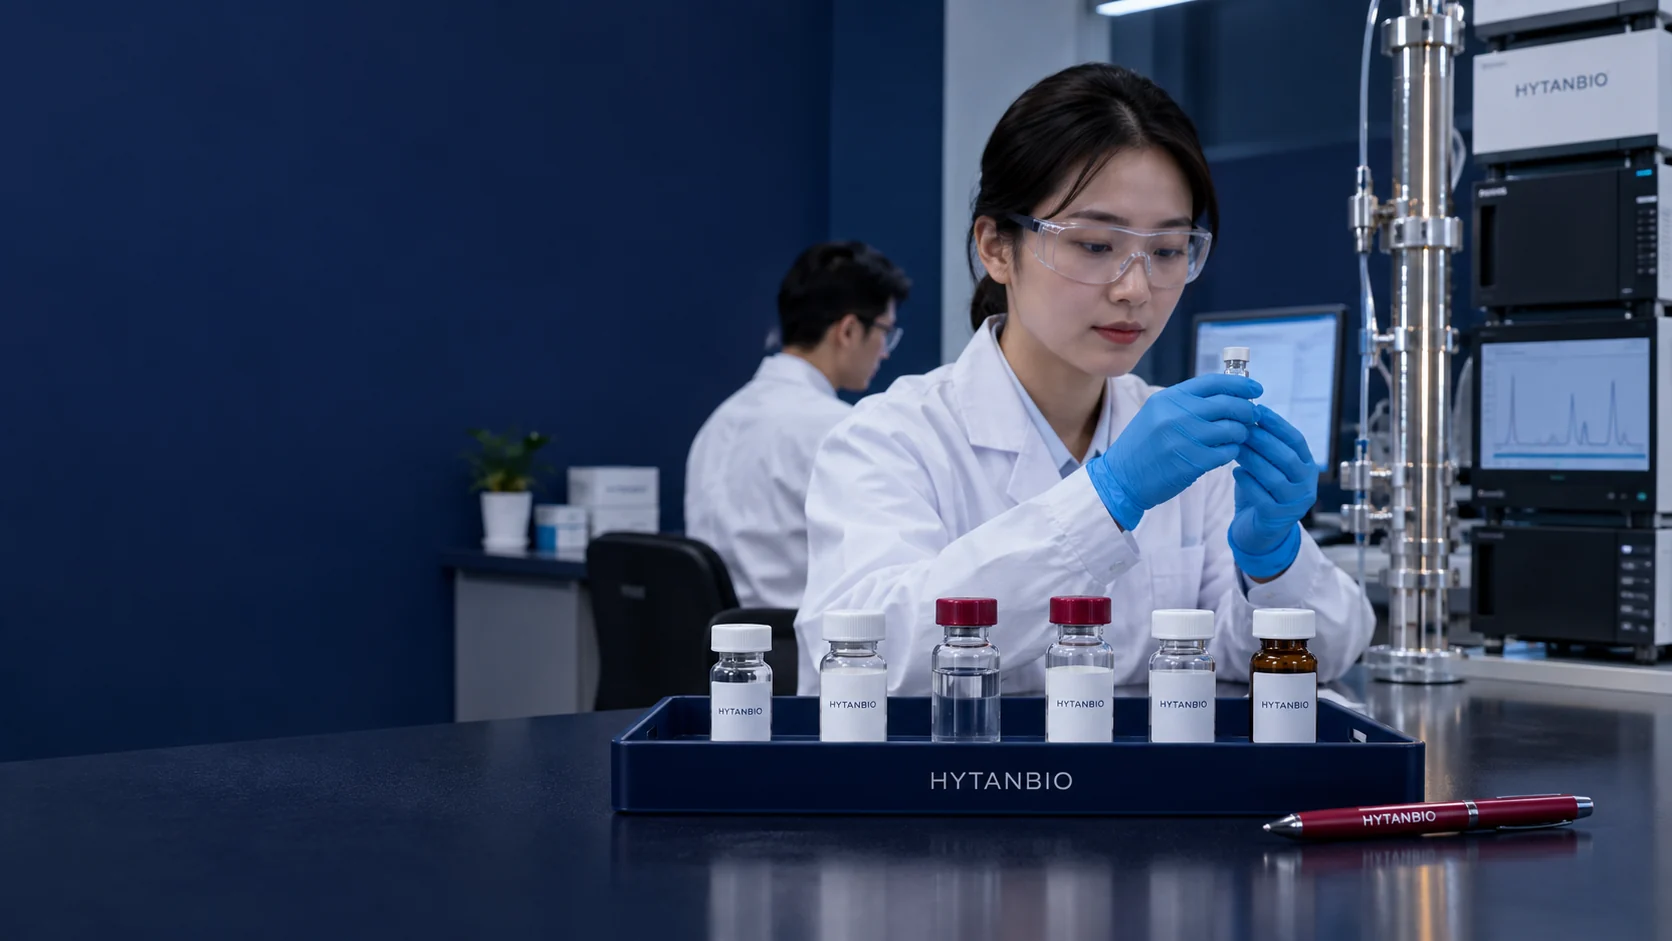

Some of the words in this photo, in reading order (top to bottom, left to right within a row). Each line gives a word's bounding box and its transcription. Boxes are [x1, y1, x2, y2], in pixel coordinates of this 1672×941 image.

[1515, 71, 1608, 98] HYTANBIO
[829, 700, 877, 709] HYTANBIO
[1056, 699, 1104, 709] HYTANBIO
[1160, 699, 1208, 709] HYTANBIO
[1262, 700, 1309, 710] HYTANBIO
[718, 707, 763, 716] HYTANBIO
[930, 771, 1073, 791] HYTANBIO
[1362, 810, 1437, 827] HYTANBIO
